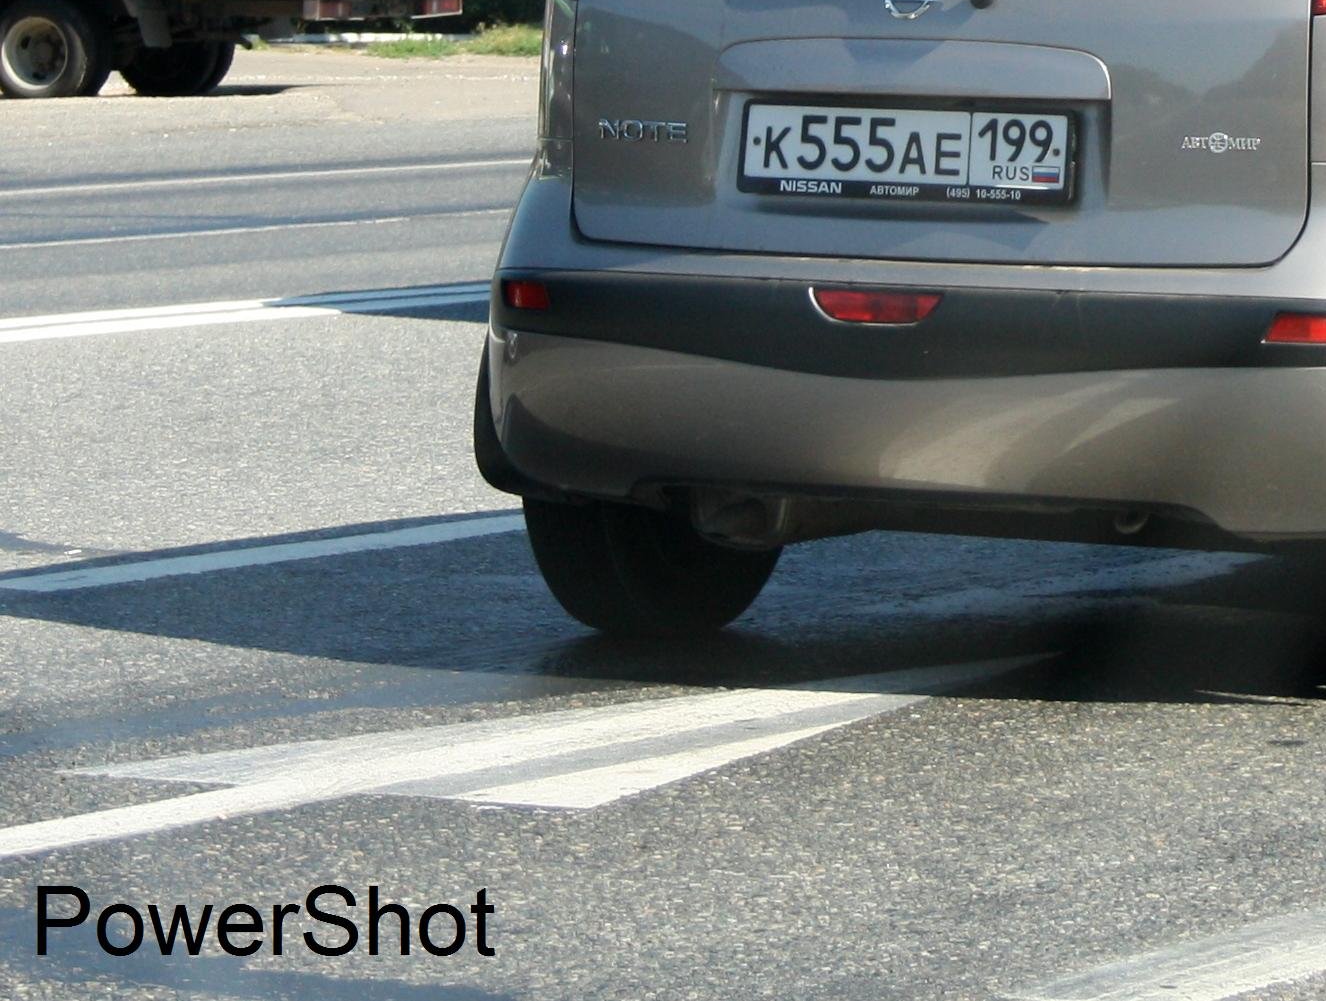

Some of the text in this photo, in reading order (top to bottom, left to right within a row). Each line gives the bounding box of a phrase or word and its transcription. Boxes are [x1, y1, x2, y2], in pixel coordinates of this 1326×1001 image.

[598, 118, 689, 144] NOTE
[763, 115, 1054, 177] К555АЕ 199
[991, 165, 1030, 181] RUS
[780, 179, 842, 195] NISSAN
[869, 184, 1022, 200] АВТОМИР (495) 10-555-10
